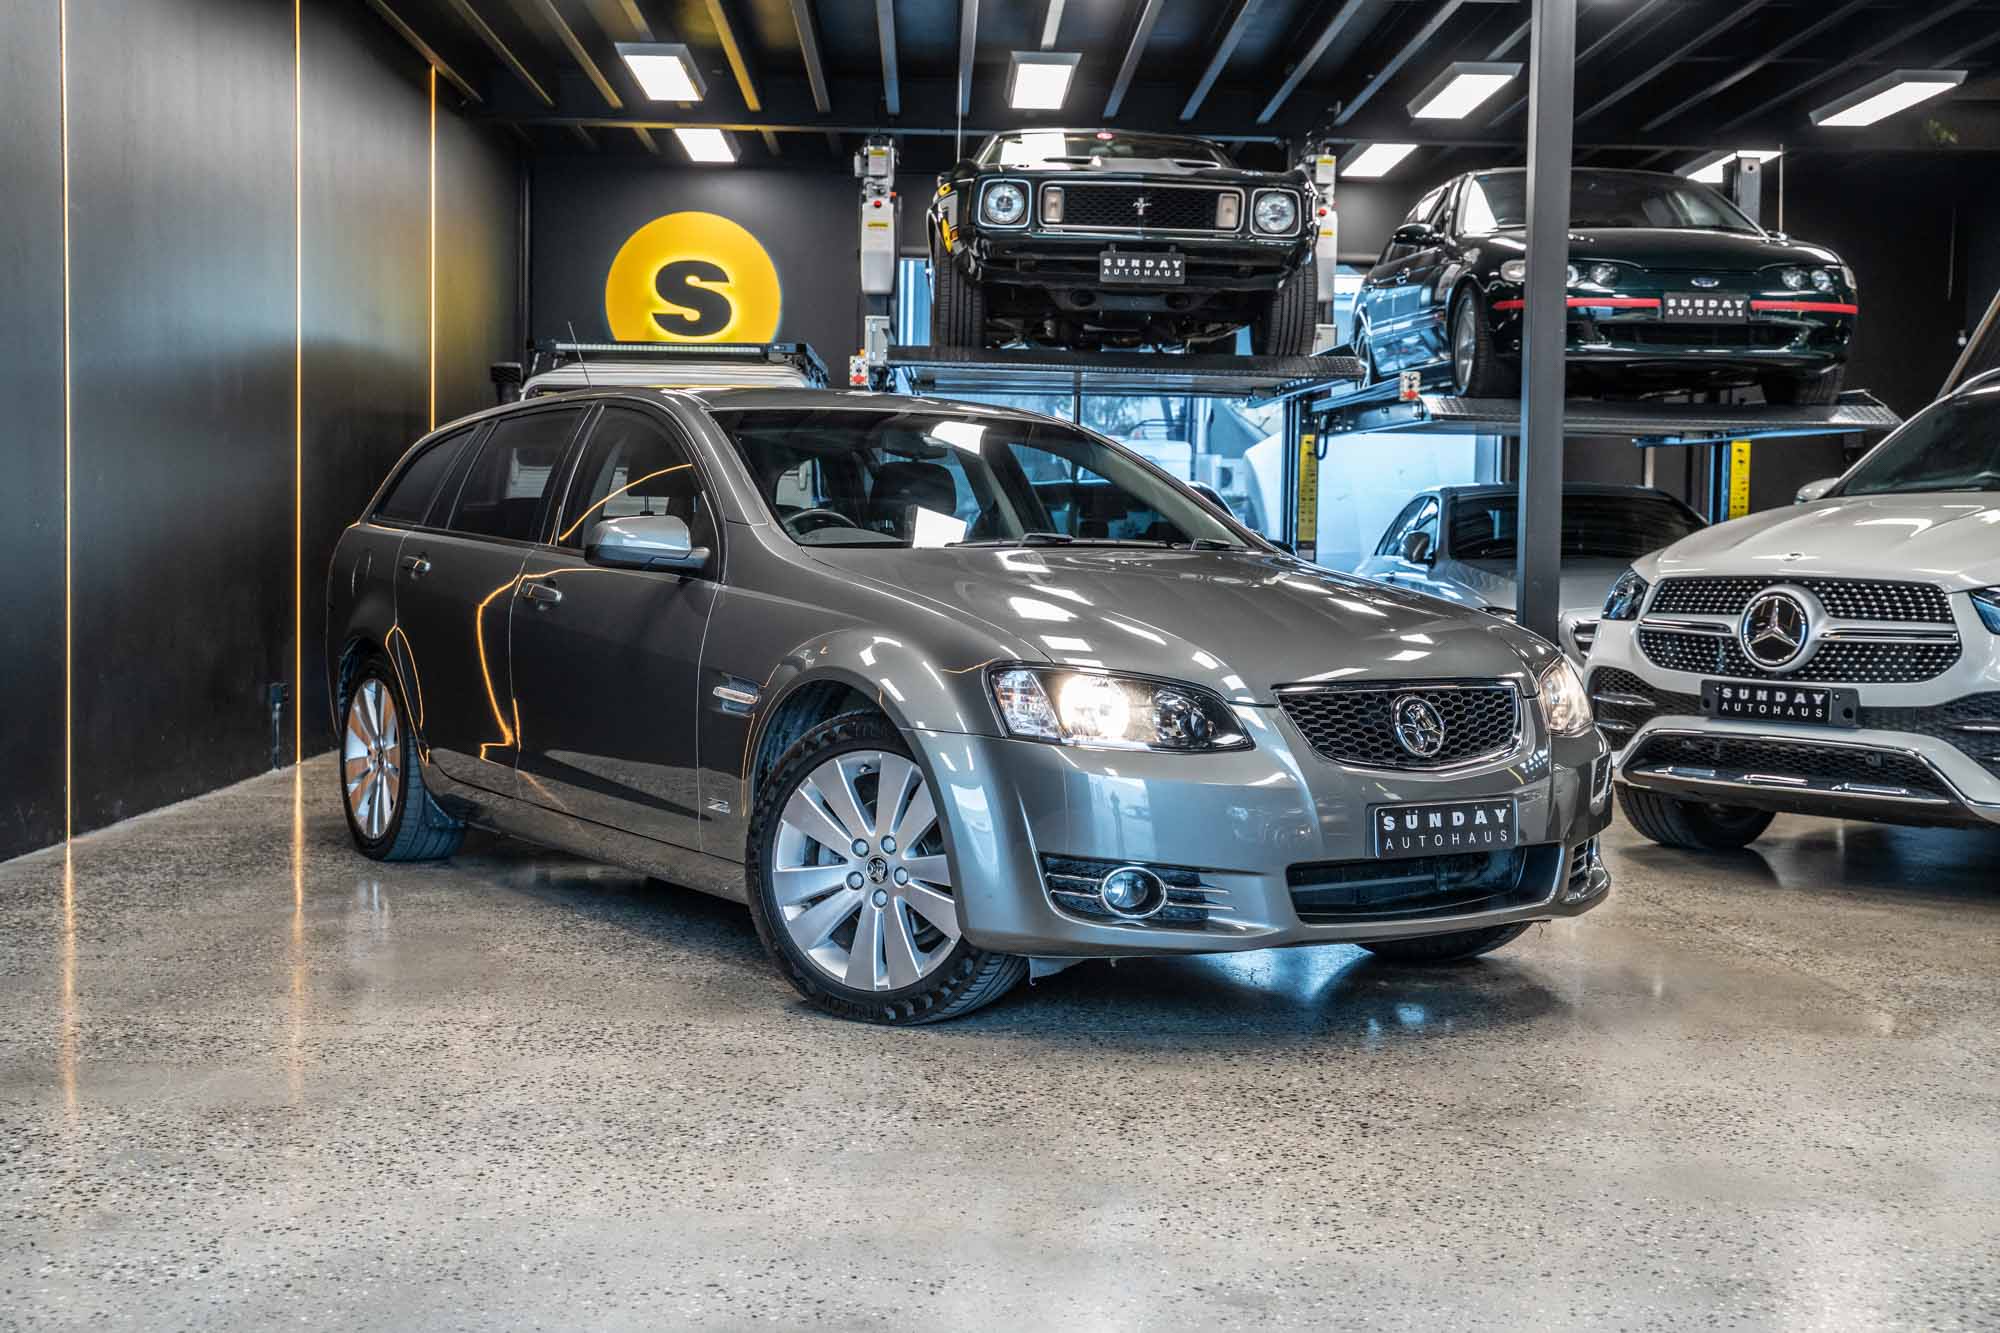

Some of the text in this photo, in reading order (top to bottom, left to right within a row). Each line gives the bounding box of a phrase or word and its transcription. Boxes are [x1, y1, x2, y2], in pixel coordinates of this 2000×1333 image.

[1103, 258, 1181, 268] SUNDAY
[1103, 268, 1180, 277] AUTOHAUS
[652, 260, 732, 336] S
[1667, 298, 1744, 308] SUNDAY
[1667, 308, 1743, 317] AUTOHAUS
[1721, 688, 1825, 705] SUNDAY
[1721, 702, 1823, 718] AUTOHAUS
[1383, 809, 1507, 831] SUNDAY
[1385, 830, 1508, 850] AUTOHAUS
